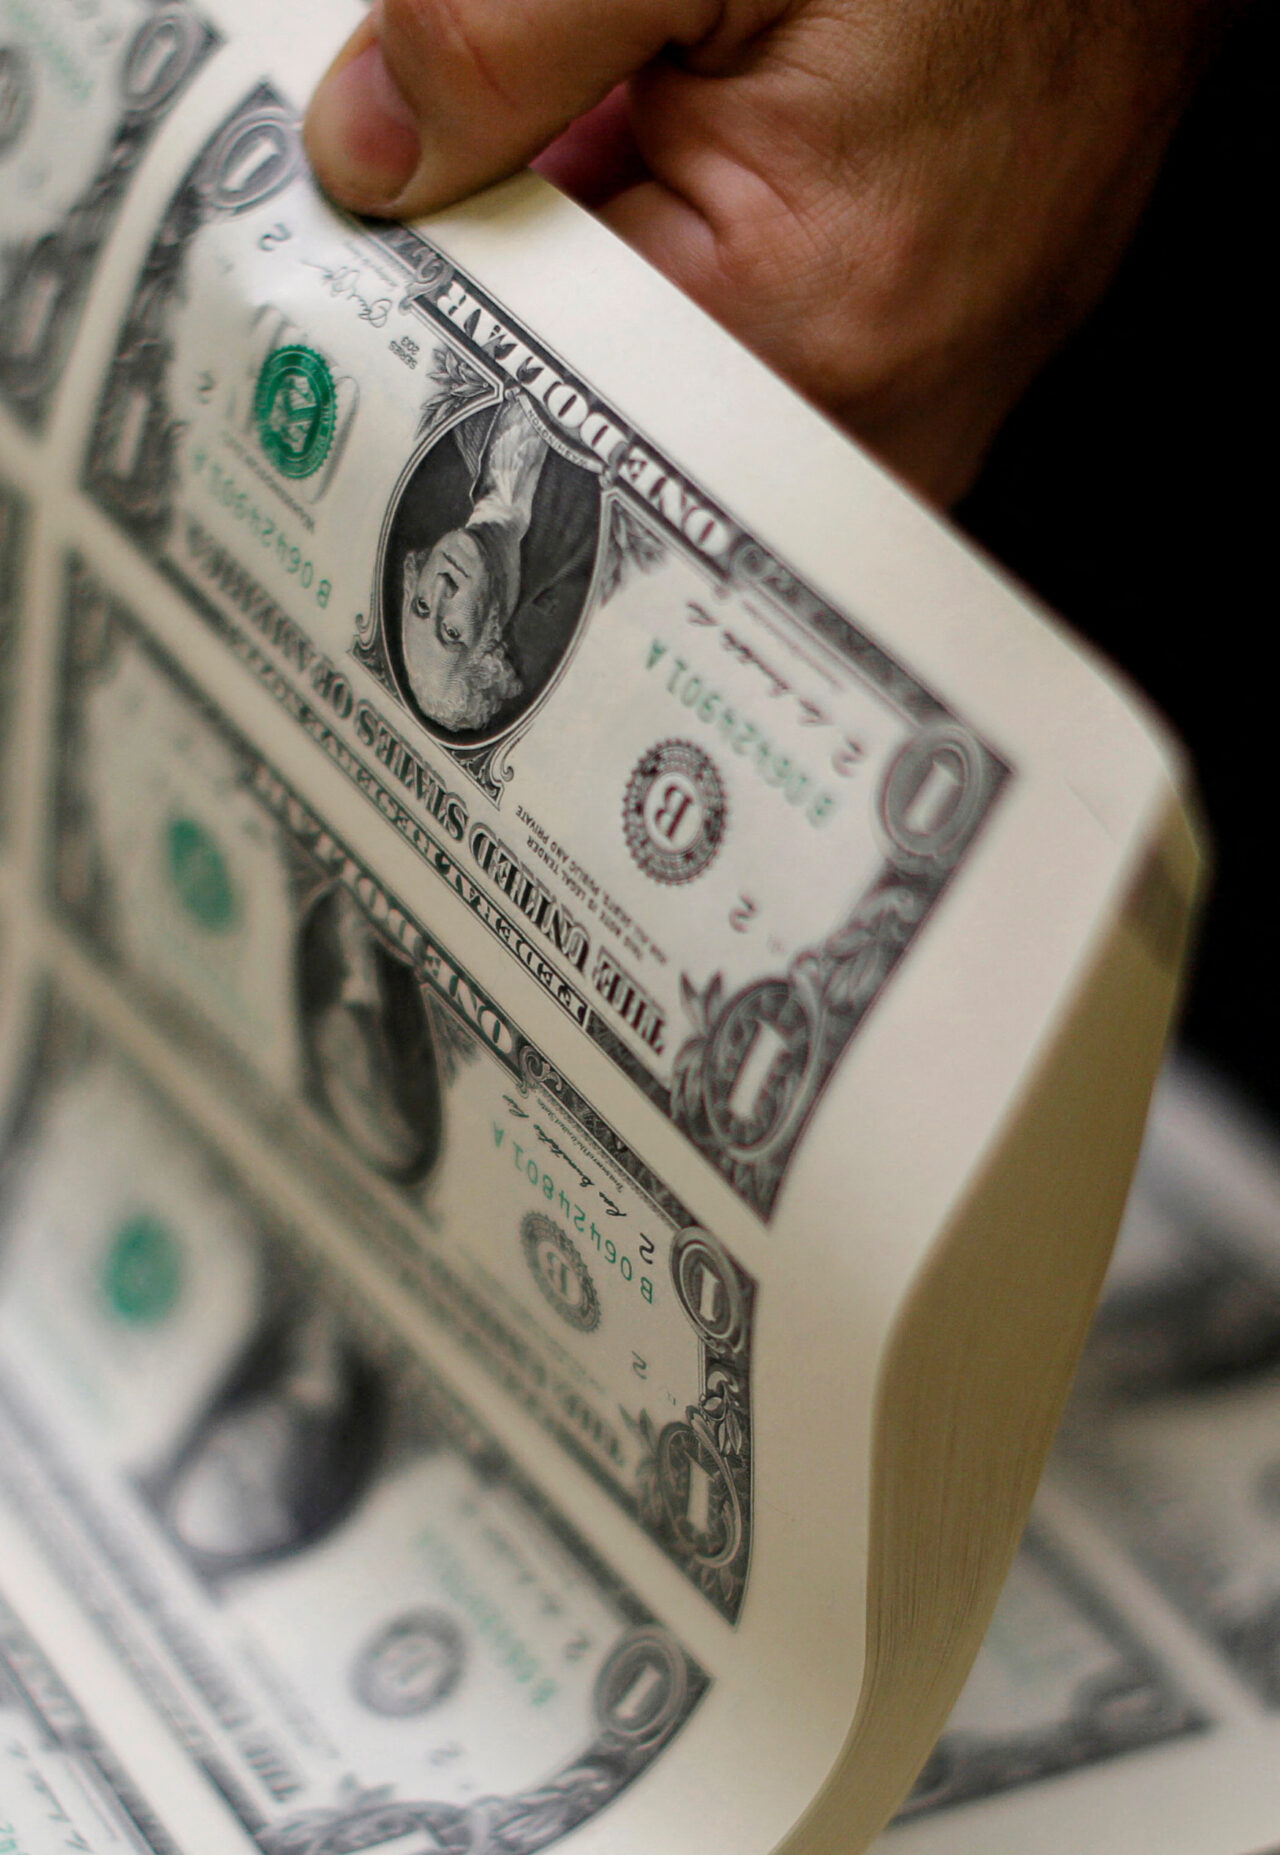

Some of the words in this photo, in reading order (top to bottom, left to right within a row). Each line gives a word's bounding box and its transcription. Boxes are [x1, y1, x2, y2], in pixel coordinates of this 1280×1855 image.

[386, 338, 419, 370] SERIES
[431, 276, 629, 463] DOLLAR
[612, 441, 737, 560] ONE
[310, 655, 356, 724] OF
[292, 700, 445, 864] RESERVE
[351, 699, 472, 843] STATES
[515, 804, 553, 845] PRIVATE
[654, 786, 693, 838] B
[525, 835, 561, 874] TENDER
[547, 839, 570, 863] AND
[557, 868, 588, 900] LEGAL
[565, 858, 603, 895] PUBLIC
[468, 821, 592, 974] UNITED
[438, 854, 586, 1018] FEDERAL
[420, 943, 511, 1055] ONE
[593, 950, 669, 1053] THE
[634, 1231, 656, 1266] 2
